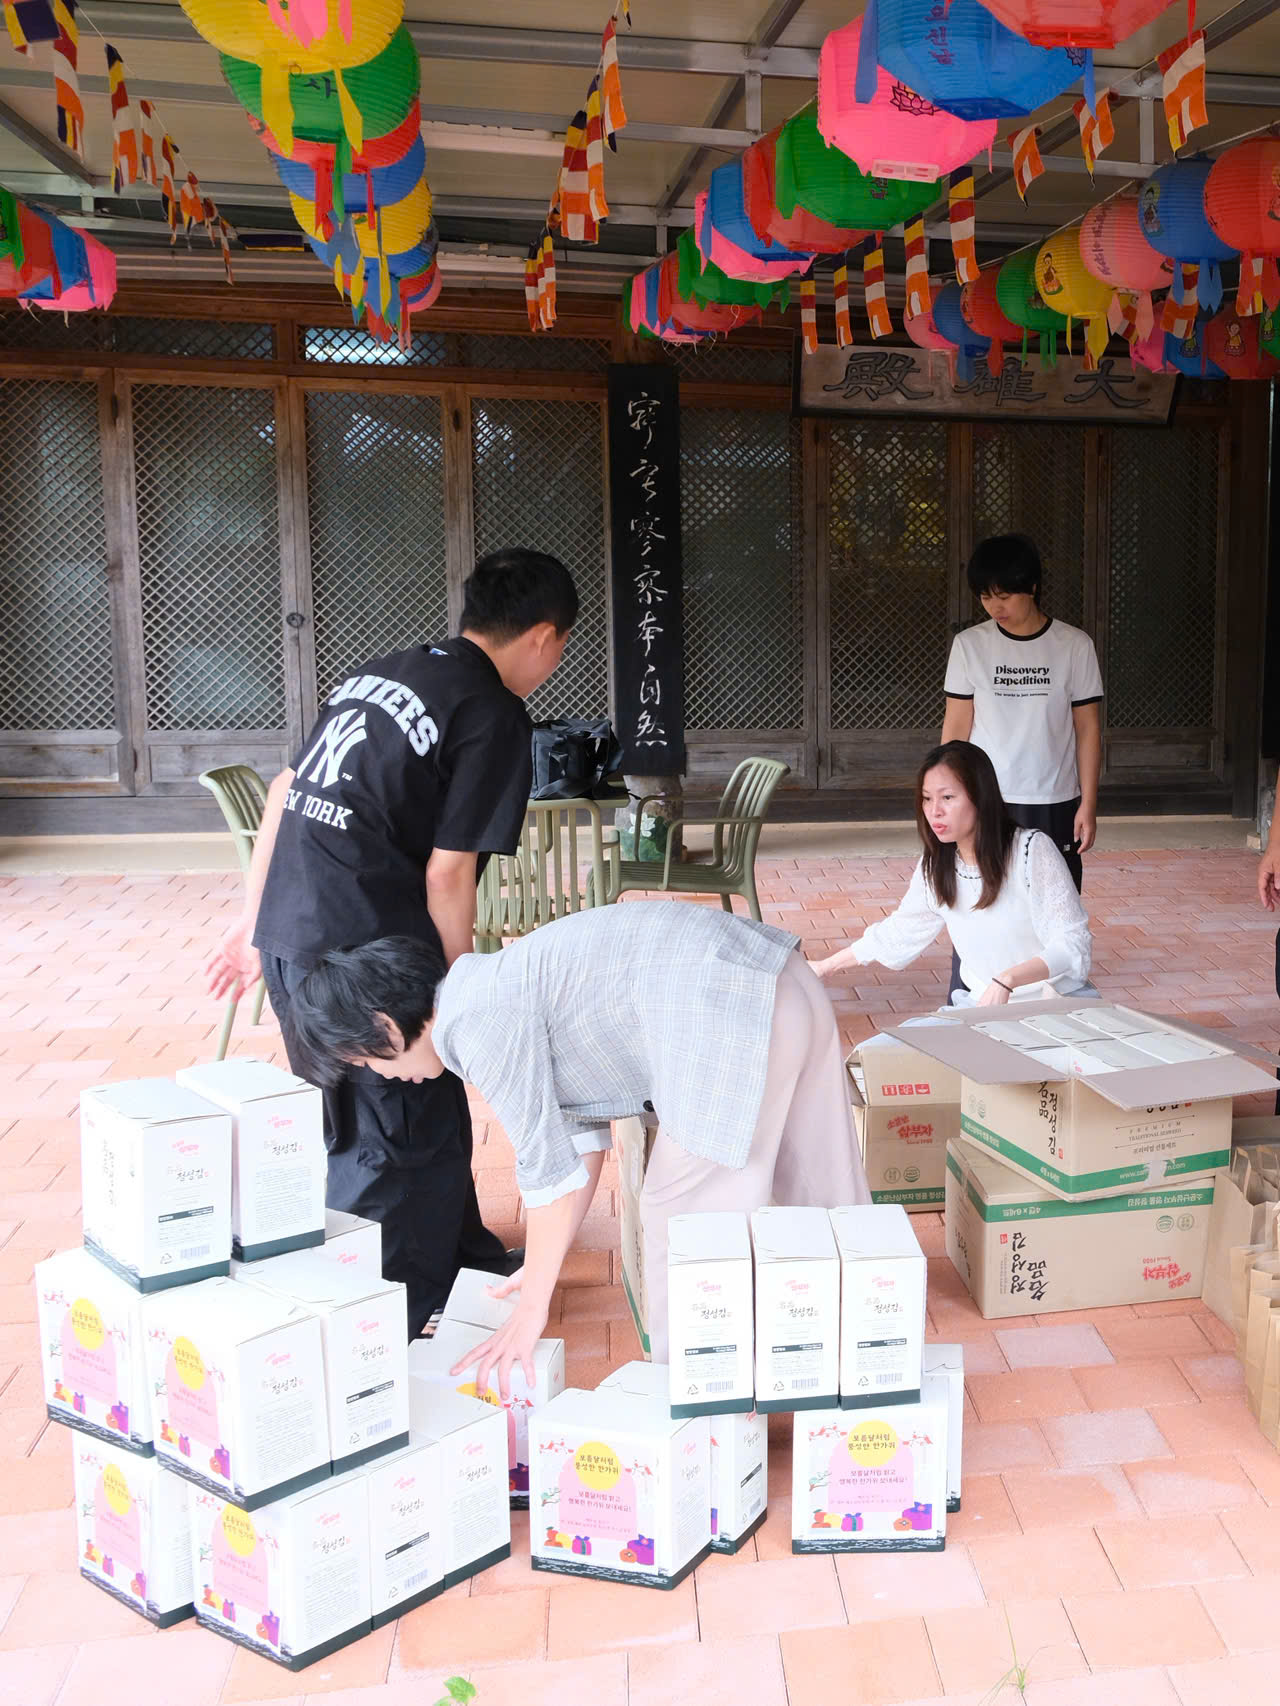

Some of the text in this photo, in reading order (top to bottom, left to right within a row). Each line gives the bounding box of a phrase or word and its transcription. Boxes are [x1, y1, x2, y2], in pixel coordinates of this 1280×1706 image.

[995, 665, 1050, 676] Discovery
[994, 676, 1051, 686] Expedition
[897, 1123, 934, 1139] 삼부자
[1047, 1092, 1058, 1156] 정성김
[1010, 1231, 1027, 1295] 정성김
[1141, 1263, 1181, 1281] 삼부자
[1026, 1259, 1048, 1302] 名品
[700, 1307, 726, 1320] 정성김
[788, 1306, 814, 1318] 정성김
[874, 1302, 899, 1314] 정성김
